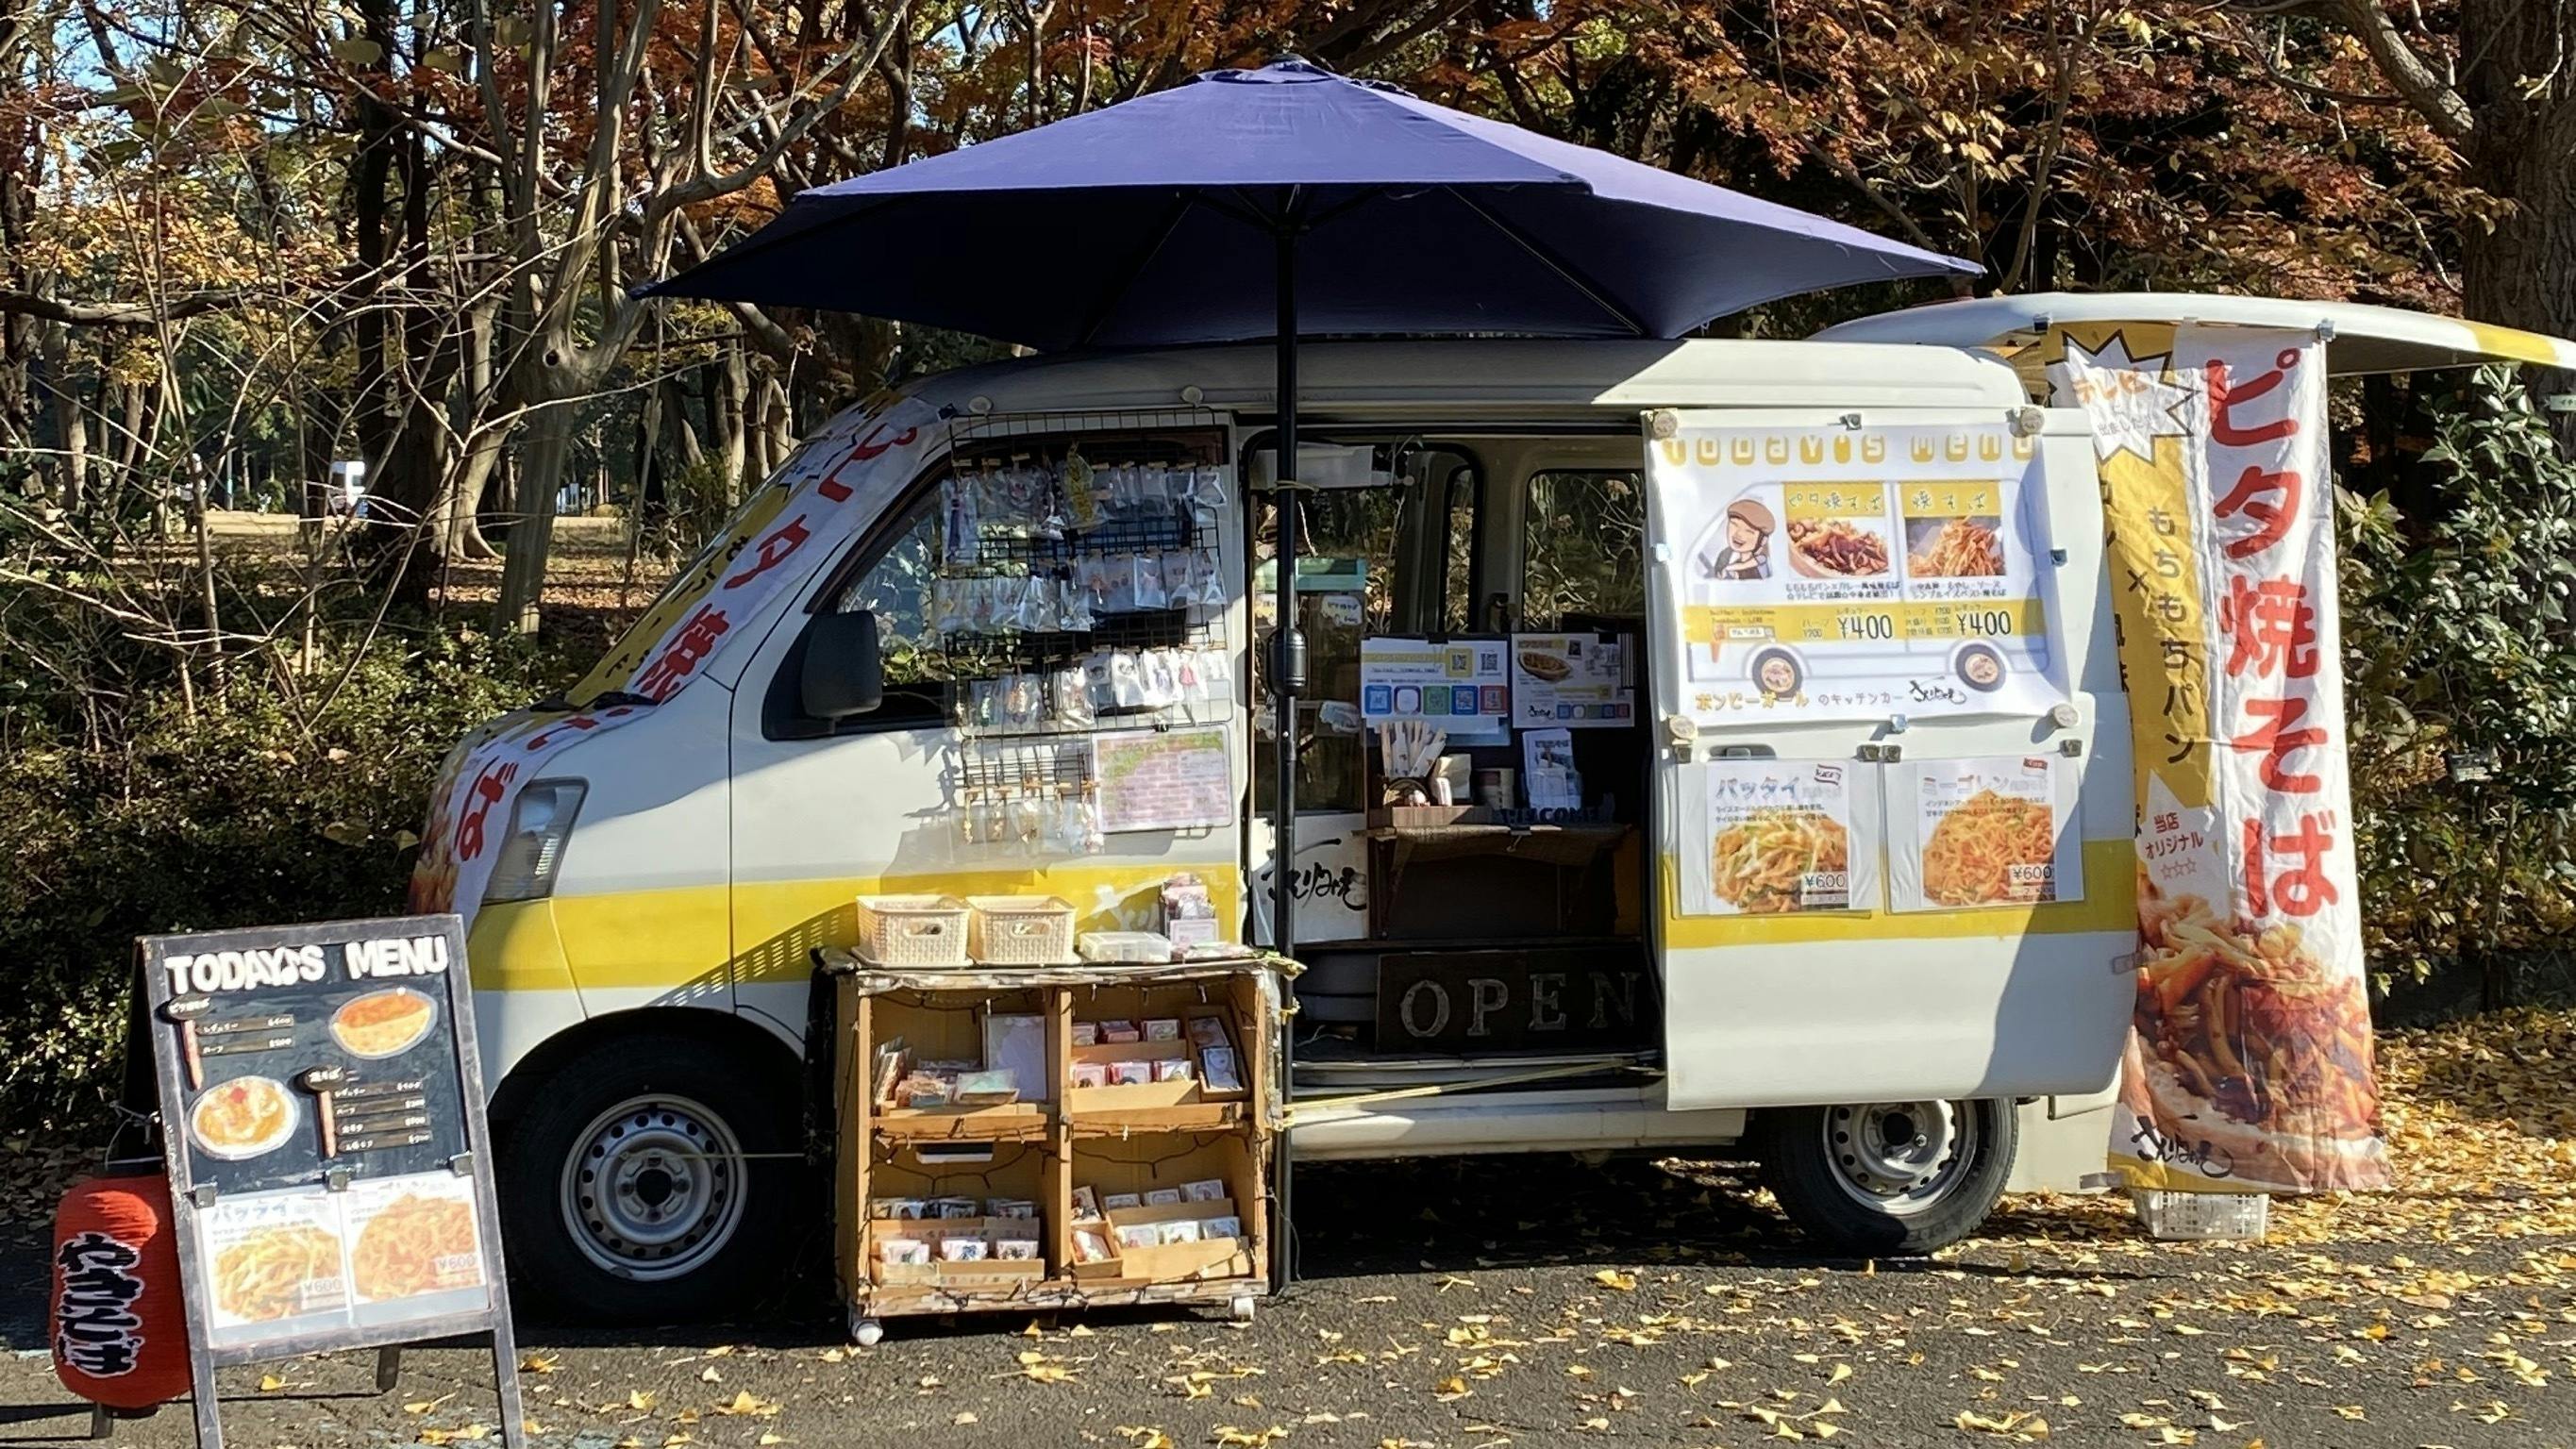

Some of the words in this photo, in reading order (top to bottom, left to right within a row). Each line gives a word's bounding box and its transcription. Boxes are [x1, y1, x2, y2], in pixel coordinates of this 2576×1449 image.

[1836, 614, 1894, 641] ¥400
[1956, 610, 2013, 636] ¥400
[2148, 506, 2196, 763] もちもちパン
[2205, 347, 2339, 919] ピタ焼そば
[1715, 775, 1800, 801] パッタイ
[2152, 811, 2180, 830] 当店
[2144, 831, 2204, 858] オリジナル
[1804, 874, 1847, 888] ¥600
[2013, 865, 2052, 880] ¥600
[344, 936, 449, 980] MENU
[1399, 971, 1642, 1039] OPEN
[438, 1256, 477, 1270] ¥600
[303, 1279, 343, 1293] ¥600
